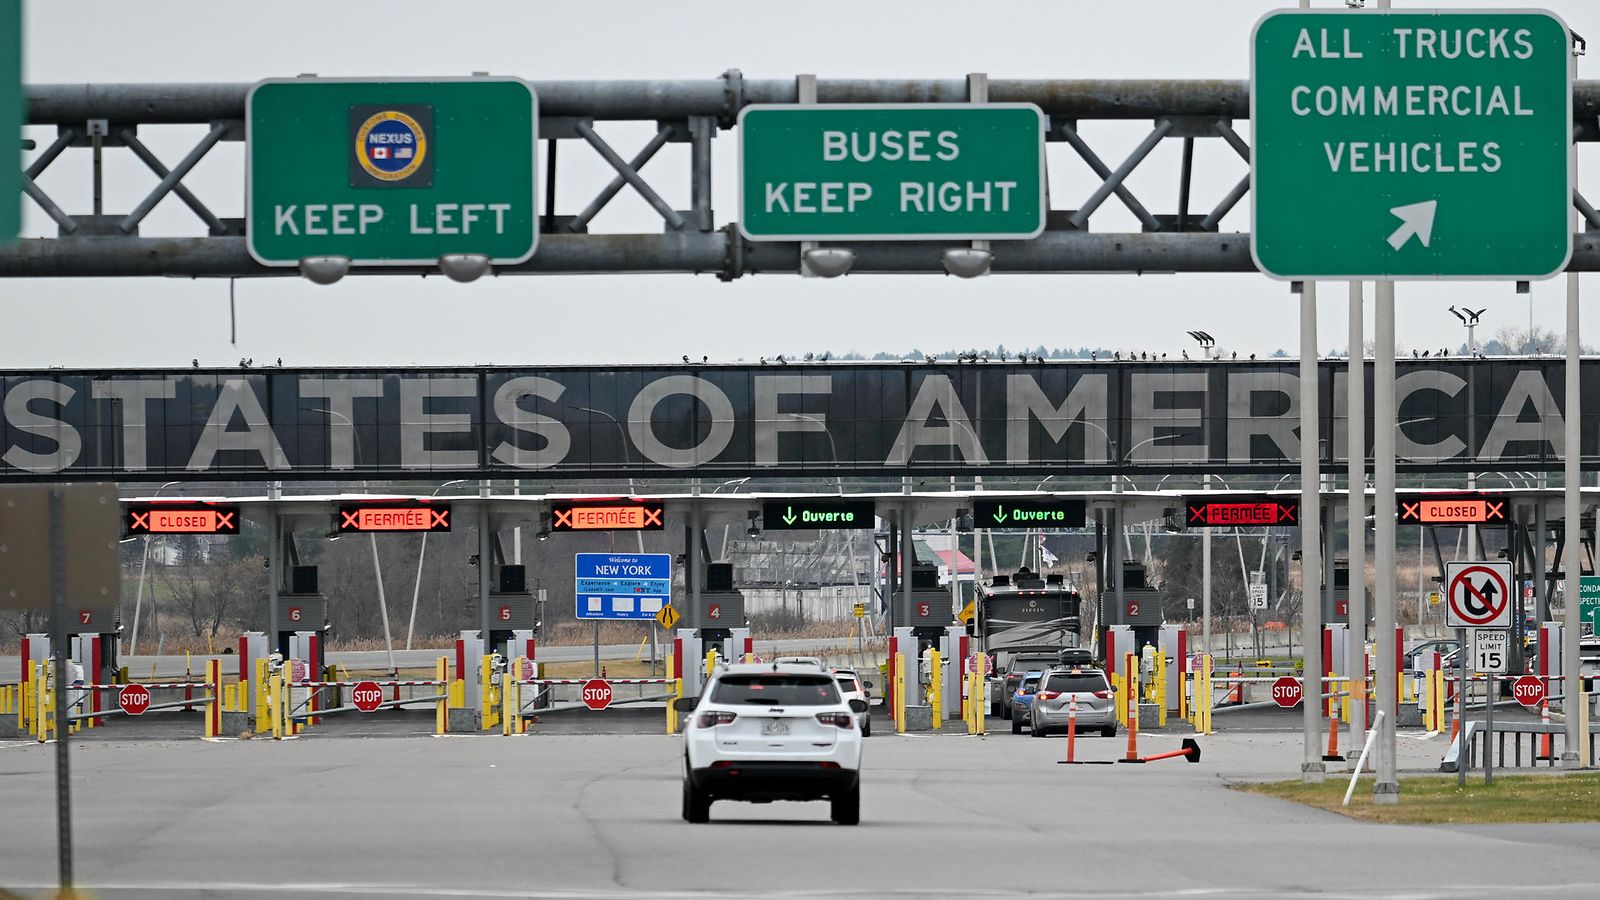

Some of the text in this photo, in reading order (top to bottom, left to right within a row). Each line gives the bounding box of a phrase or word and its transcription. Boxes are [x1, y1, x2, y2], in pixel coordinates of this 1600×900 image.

[1293, 27, 1534, 60] ALL TRUCKS
[1291, 84, 1534, 117] COMMERCIAL
[369, 134, 413, 144] NEXUS
[823, 130, 960, 162] BUSES
[1324, 141, 1502, 173] VEHICLES
[765, 180, 1017, 214] KEEP RIGHT
[274, 203, 512, 236] KEEP LEFT
[1, 369, 1566, 473] STATES OF AMERICA
[364, 509, 424, 527] FERMÉE
[577, 507, 637, 525] FERMÉE
[802, 509, 855, 523] Ouverte
[1012, 508, 1065, 521] Ouverte
[1211, 502, 1272, 521] FERMÉE
[1429, 505, 1478, 518] CLOSED
[159, 515, 207, 528] CLOSED
[595, 565, 652, 576] NEW YORK
[1253, 598, 1264, 606] 15
[291, 609, 300, 621] 6
[503, 608, 511, 620] 5
[711, 608, 720, 618] 4
[920, 605, 930, 617] 3
[1130, 605, 1139, 616] 2
[82, 613, 90, 624] 7
[1477, 633, 1505, 641] SPEED
[1480, 652, 1502, 669] 15
[354, 690, 381, 703] STOP
[584, 688, 611, 701] STOP
[1274, 685, 1300, 698] STOP
[1516, 684, 1542, 697] STOP
[121, 694, 149, 706] STOP
